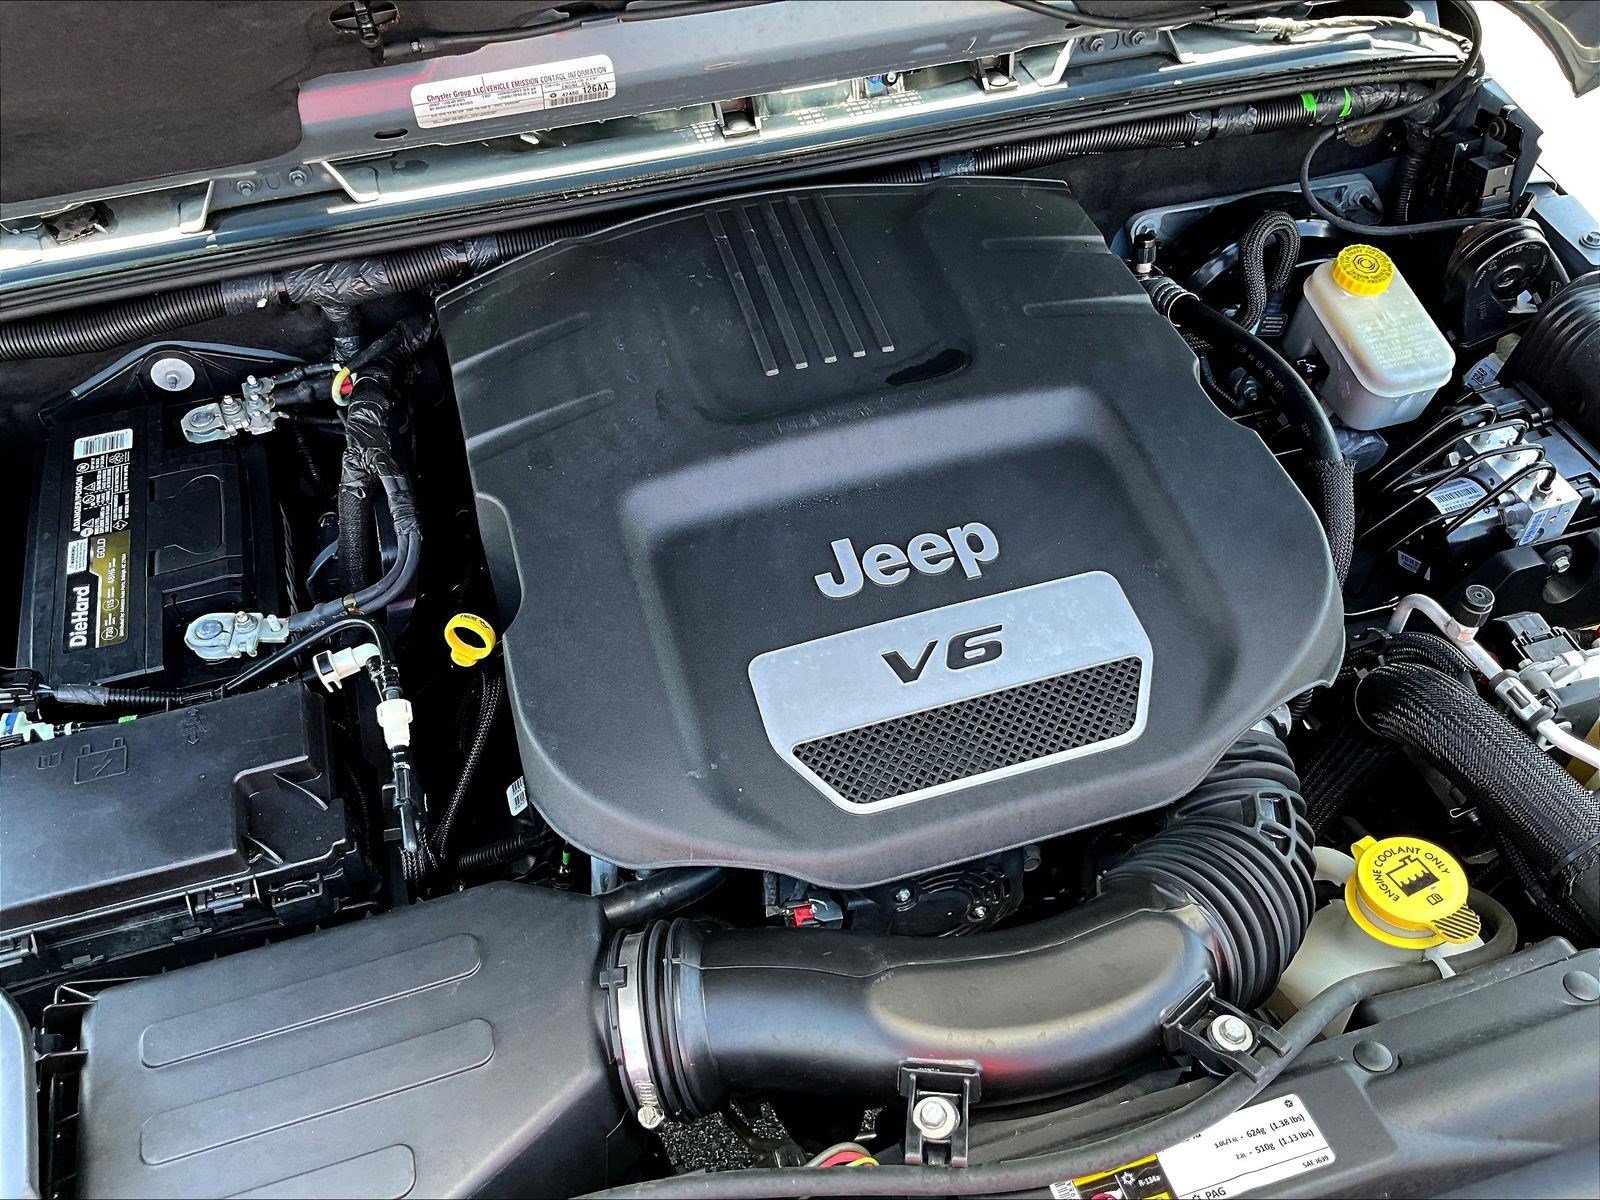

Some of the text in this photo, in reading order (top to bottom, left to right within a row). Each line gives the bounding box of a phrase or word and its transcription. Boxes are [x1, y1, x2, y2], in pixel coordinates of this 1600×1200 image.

[486, 82, 510, 92] VEHICLE
[511, 77, 539, 88] EMISSION
[540, 73, 567, 84] CONTROL
[567, 66, 607, 79] INFORMATION
[583, 82, 609, 94] 126AA
[426, 92, 452, 102] Chrysler
[453, 89, 472, 98] Group
[472, 86, 484, 95] LLC
[96, 538, 106, 559] GOLD
[814, 522, 1000, 599] Jeep
[69, 584, 90, 648] DieHard
[881, 624, 1003, 684] V6
[1372, 846, 1450, 902] ENGINE COOLANT ONLY
[1246, 1128, 1267, 1138] 624g
[1269, 1118, 1290, 1132] (1.38
[1290, 1113, 1305, 1122] lbs)
[1254, 1142, 1276, 1154] 510g
[1278, 1134, 1299, 1147] (1.13
[1299, 1128, 1315, 1138] lbs)
[1302, 1160, 1315, 1168] SAE
[1138, 1174, 1161, 1187] R-134a
[1205, 1186, 1227, 1200] PAG
